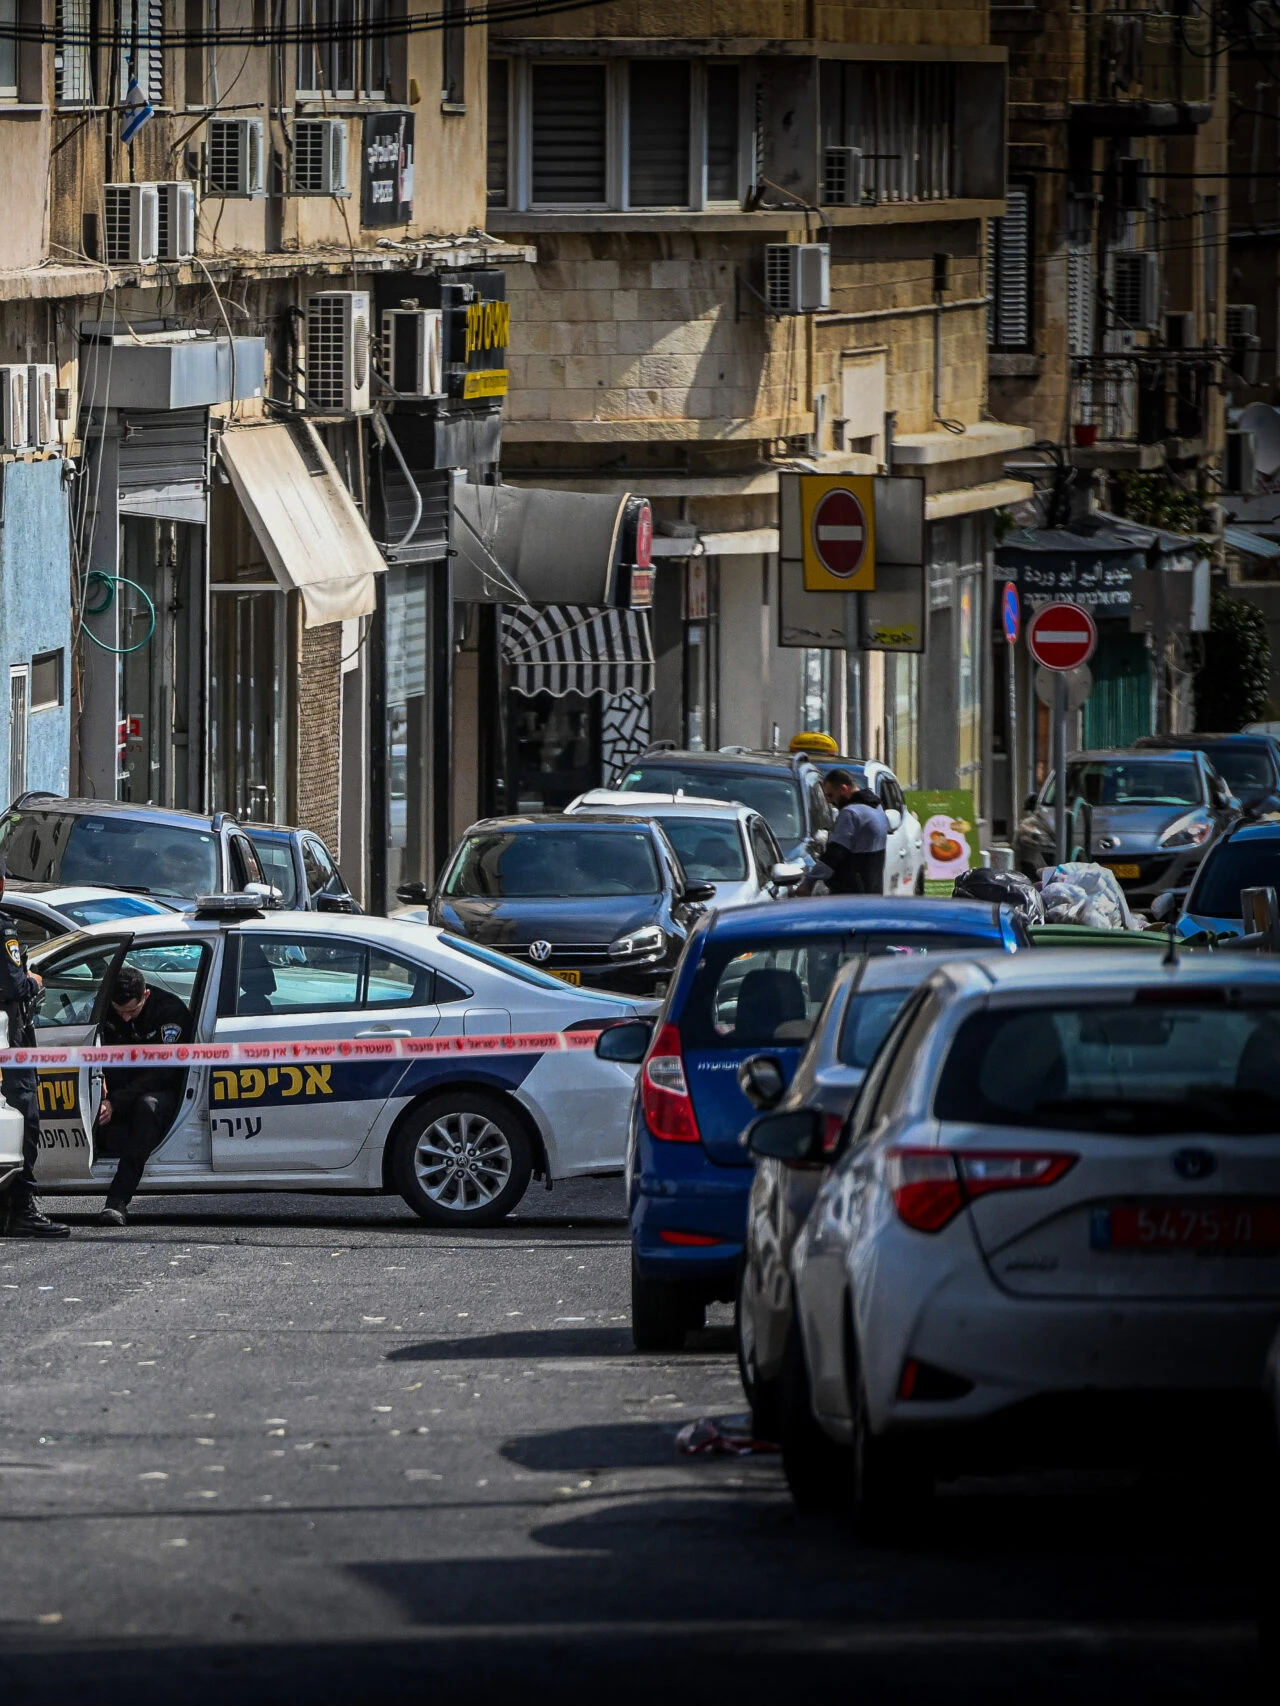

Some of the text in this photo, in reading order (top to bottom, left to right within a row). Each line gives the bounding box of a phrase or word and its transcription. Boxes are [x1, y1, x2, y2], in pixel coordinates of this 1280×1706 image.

[244, 1044, 393, 1059] משטרת ישראל אין מעבר
[407, 1038, 557, 1053] משטרת ישראל אין מעבר
[81, 1050, 230, 1063] משטרת ישראל אין מעבר
[212, 1064, 334, 1100] אכיפה
[211, 1117, 262, 1140] עירי
